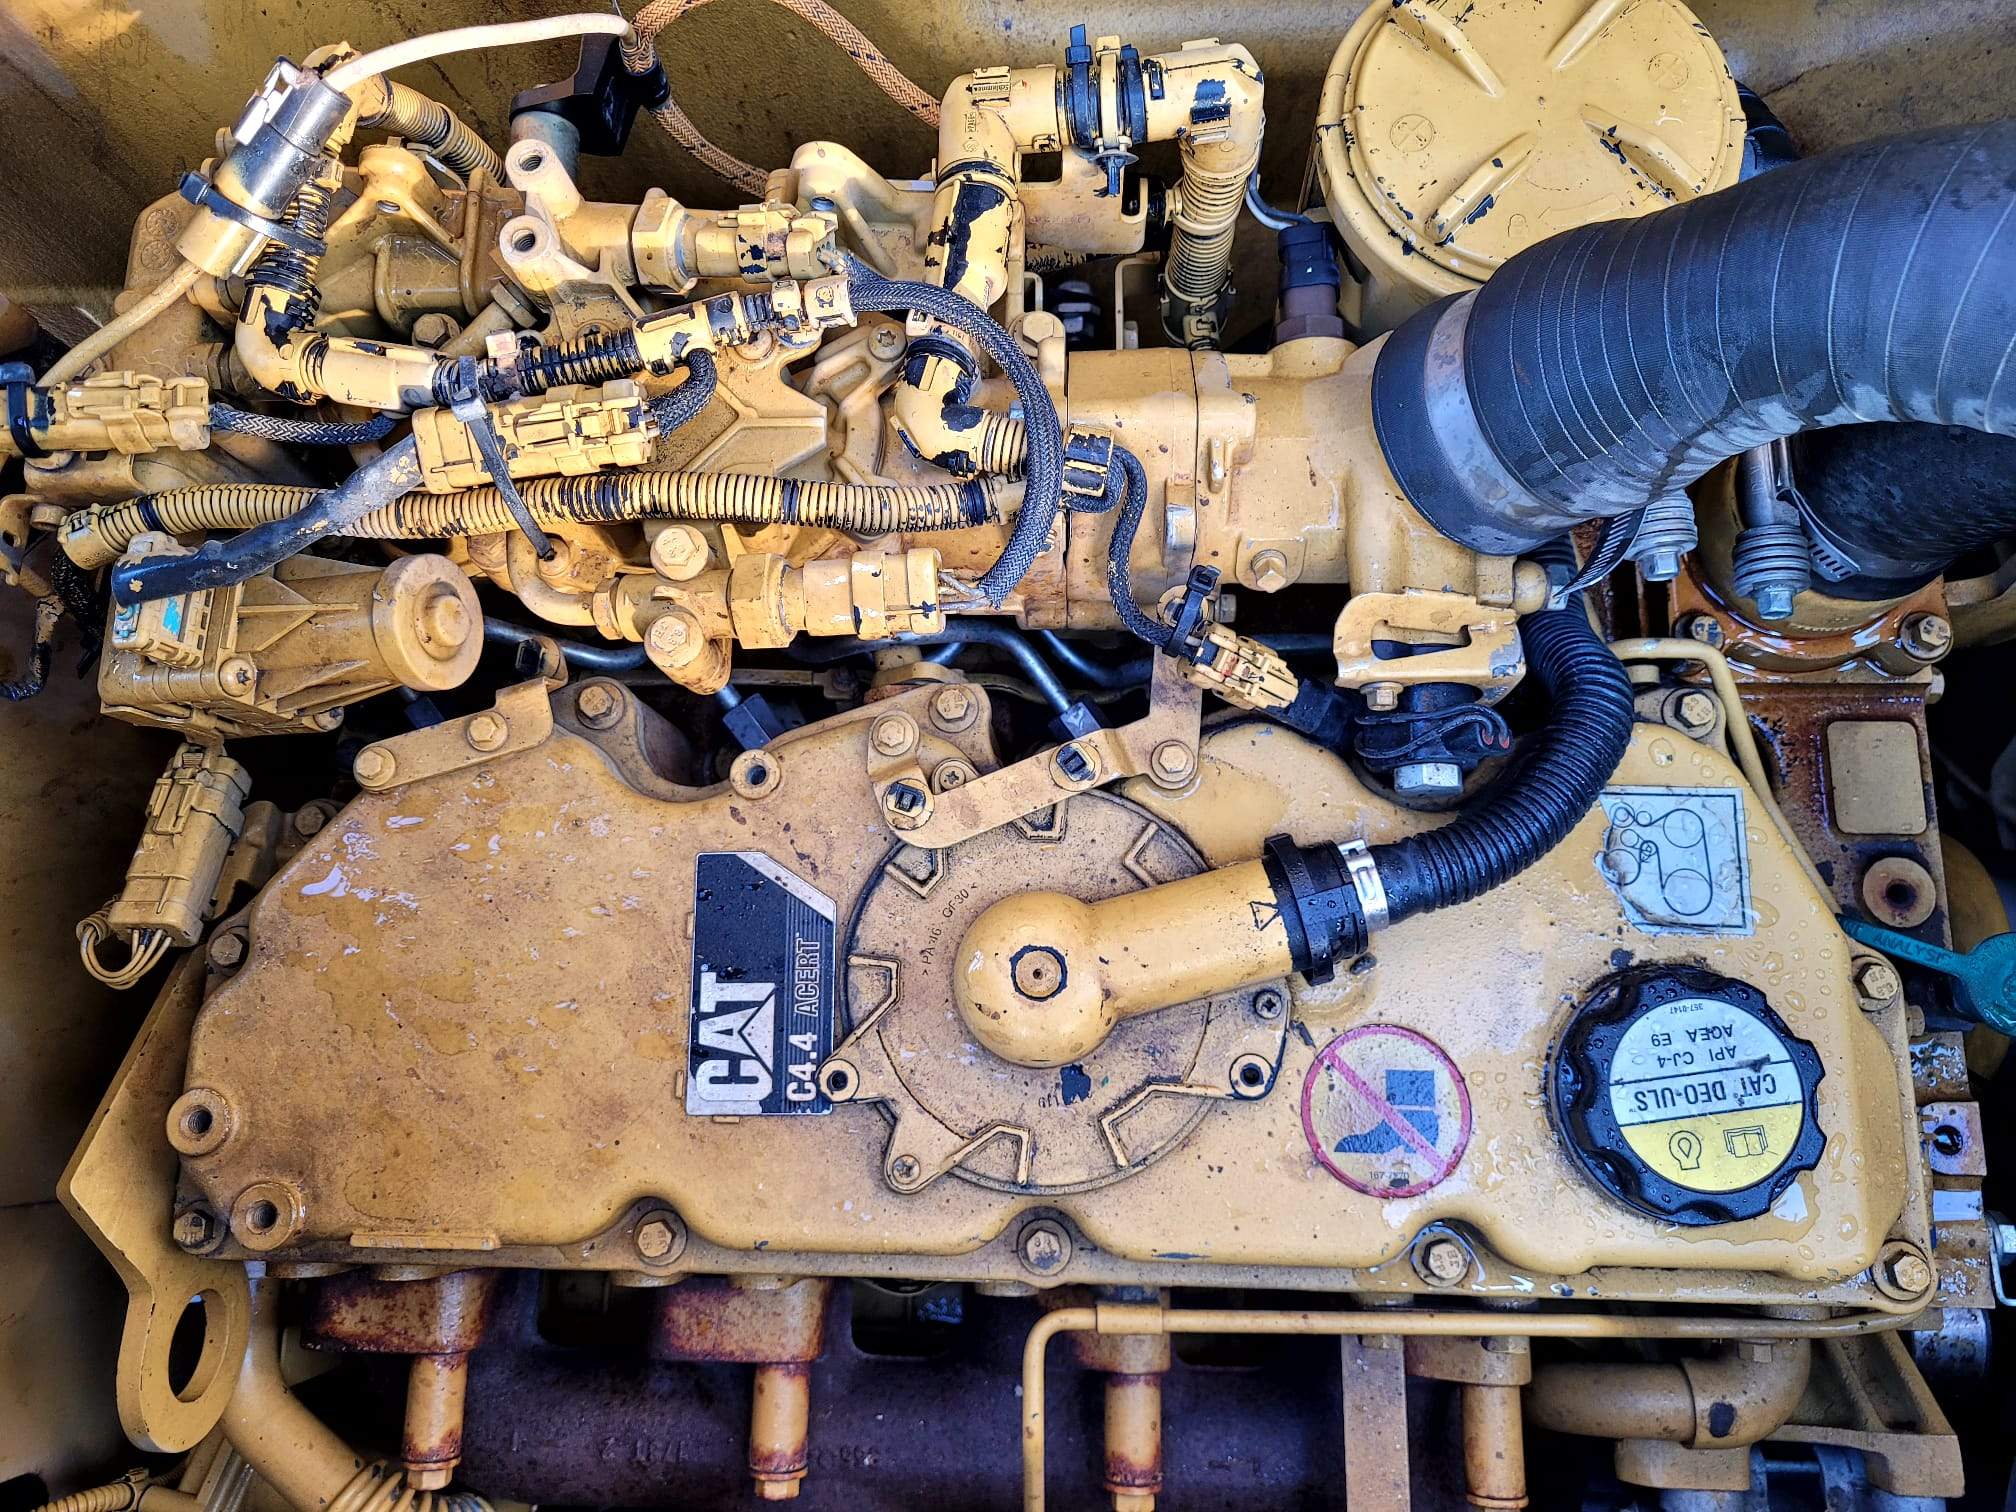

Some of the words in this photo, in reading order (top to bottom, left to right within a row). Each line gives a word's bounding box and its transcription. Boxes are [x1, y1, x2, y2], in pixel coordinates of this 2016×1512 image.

[695, 971, 776, 1102] CAT
[1651, 1032, 1672, 1047] E9
[1656, 1051, 1694, 1068] CJ-4
[1708, 1045, 1737, 1062] API
[786, 1031, 818, 1102] C4.4
